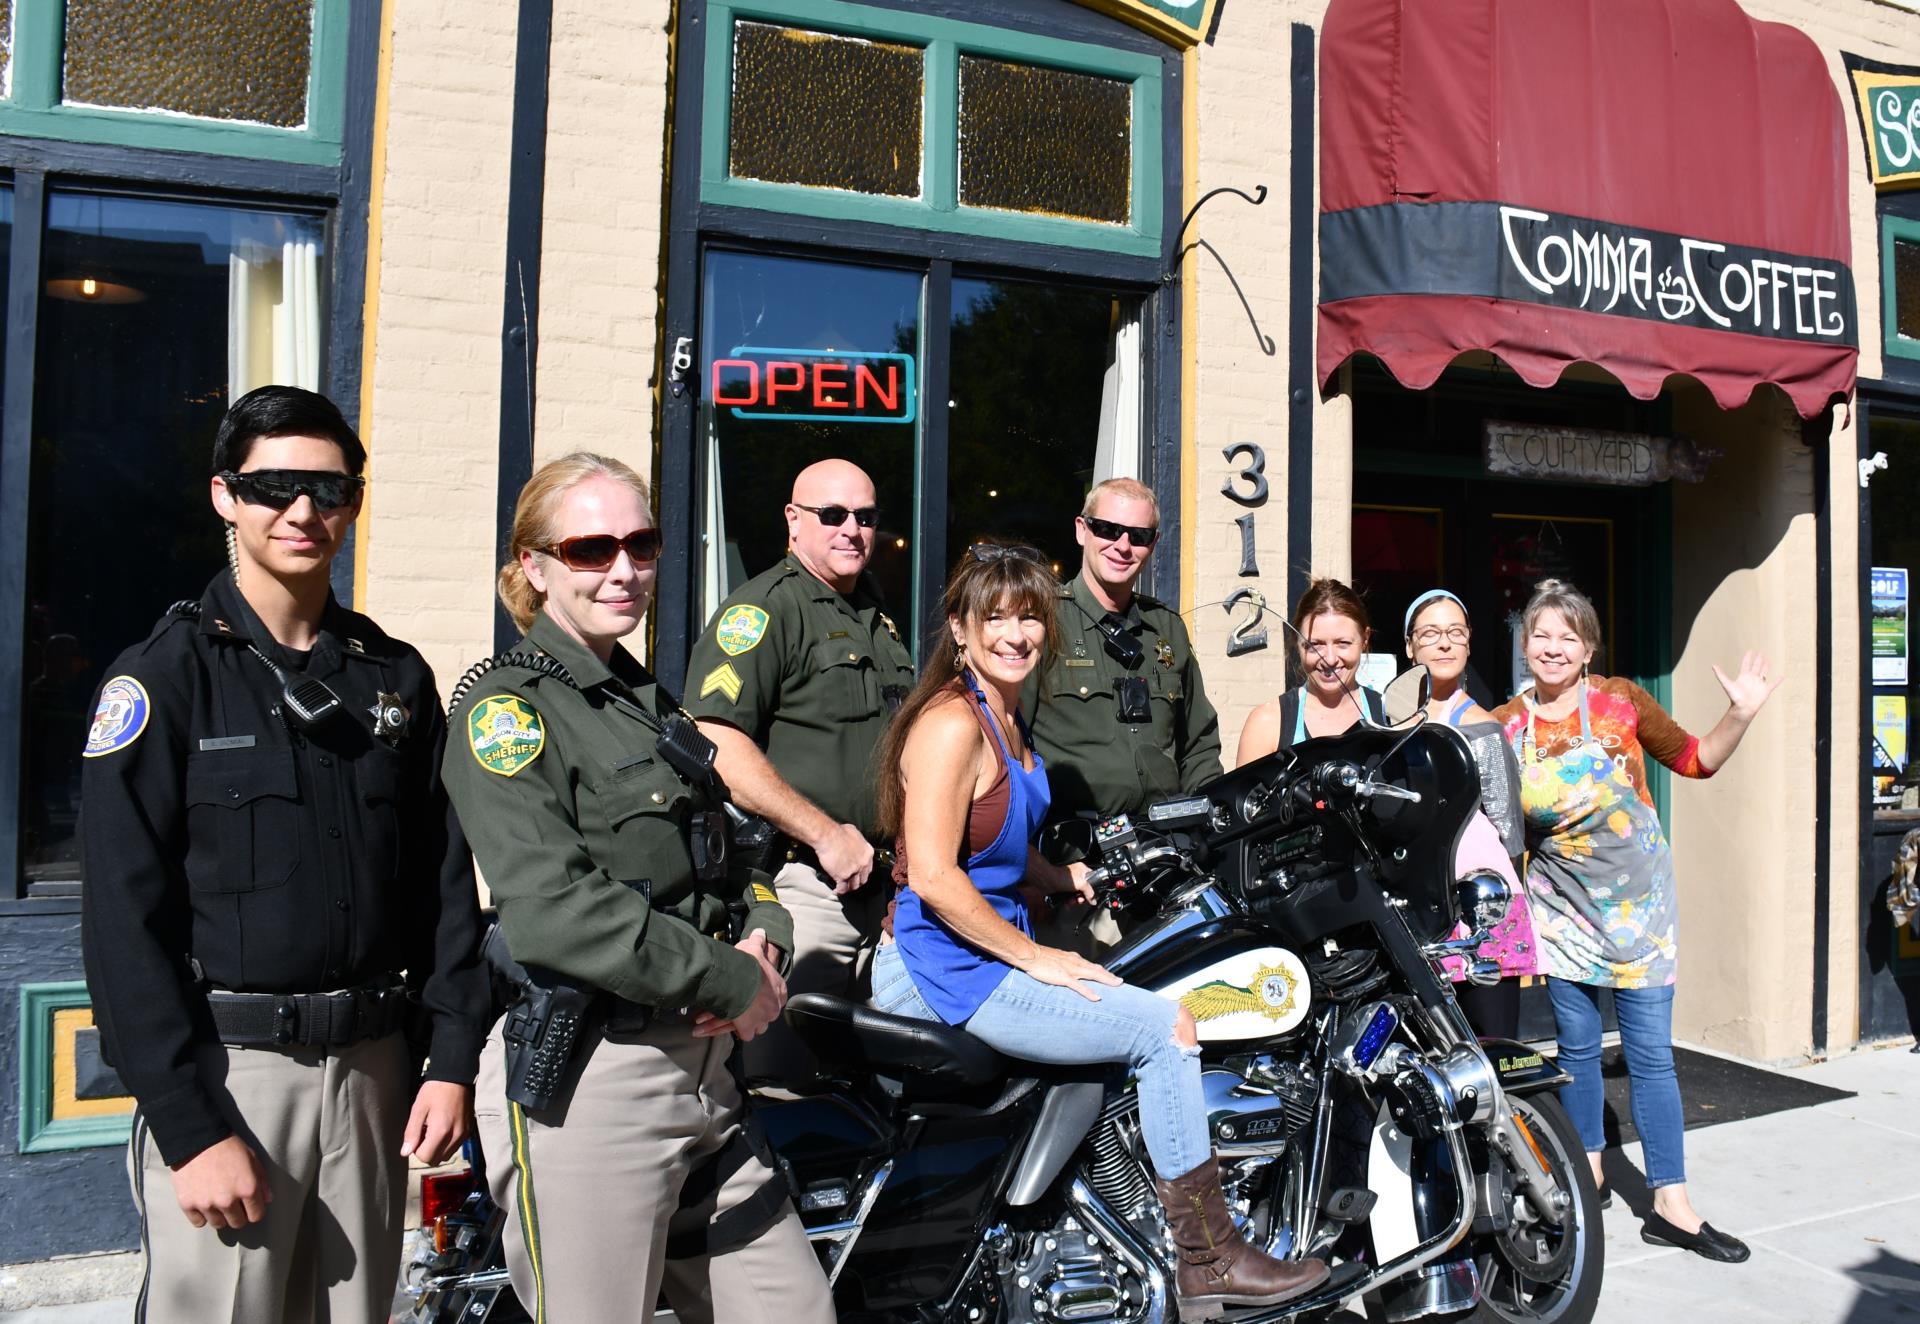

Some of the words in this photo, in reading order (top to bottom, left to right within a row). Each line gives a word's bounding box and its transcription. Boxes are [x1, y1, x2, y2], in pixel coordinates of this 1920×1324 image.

[1500, 206, 1652, 311] COMMA
[1680, 238, 1844, 336] COFFEE
[712, 359, 898, 410] OPEN
[1497, 433, 1652, 481] COURTYARD
[721, 635, 753, 648] SHERIFF
[513, 729, 531, 738] CITY
[484, 744, 536, 764] SHERIFF
[1257, 968, 1291, 977] MOTORS
[1499, 1057, 1511, 1072] M.
